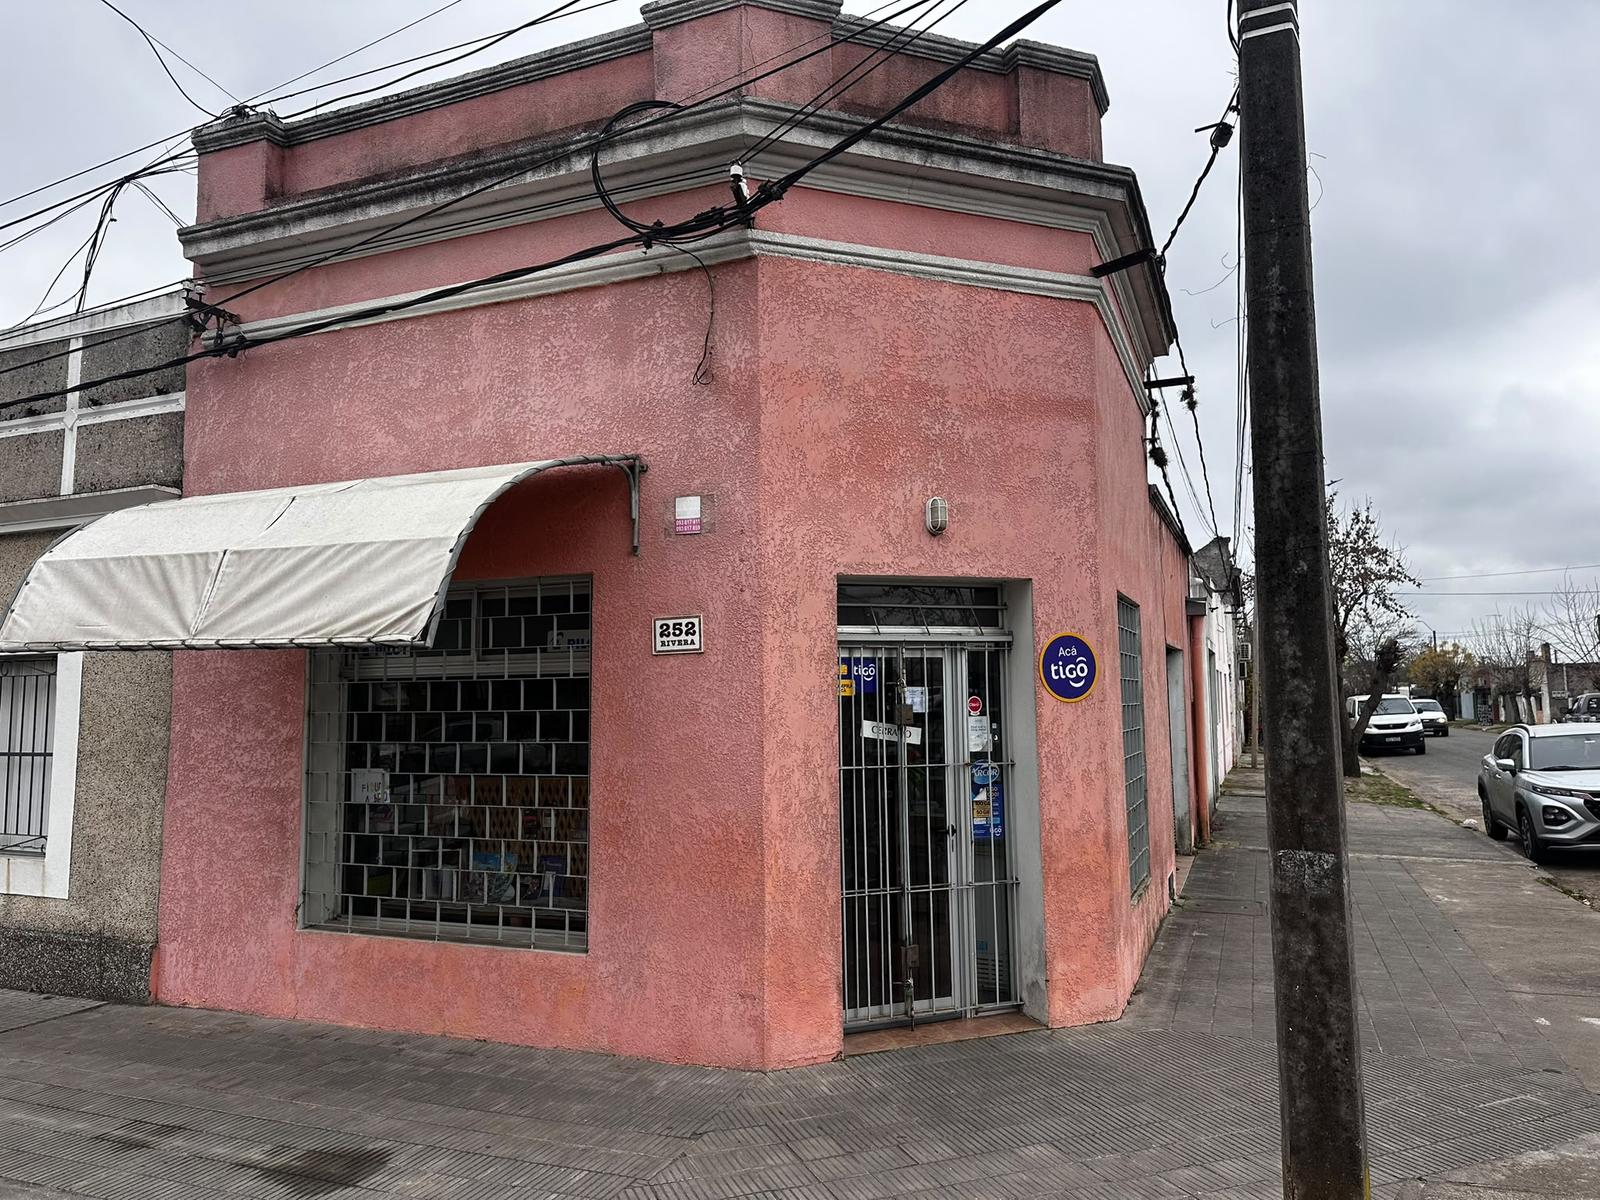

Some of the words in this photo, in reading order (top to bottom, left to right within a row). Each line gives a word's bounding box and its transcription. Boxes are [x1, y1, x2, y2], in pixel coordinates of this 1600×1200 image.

[659, 621, 697, 638] 252
[660, 638, 696, 648] RIVERA
[1058, 645, 1078, 657] Acá
[871, 725, 912, 739] CERRAO
